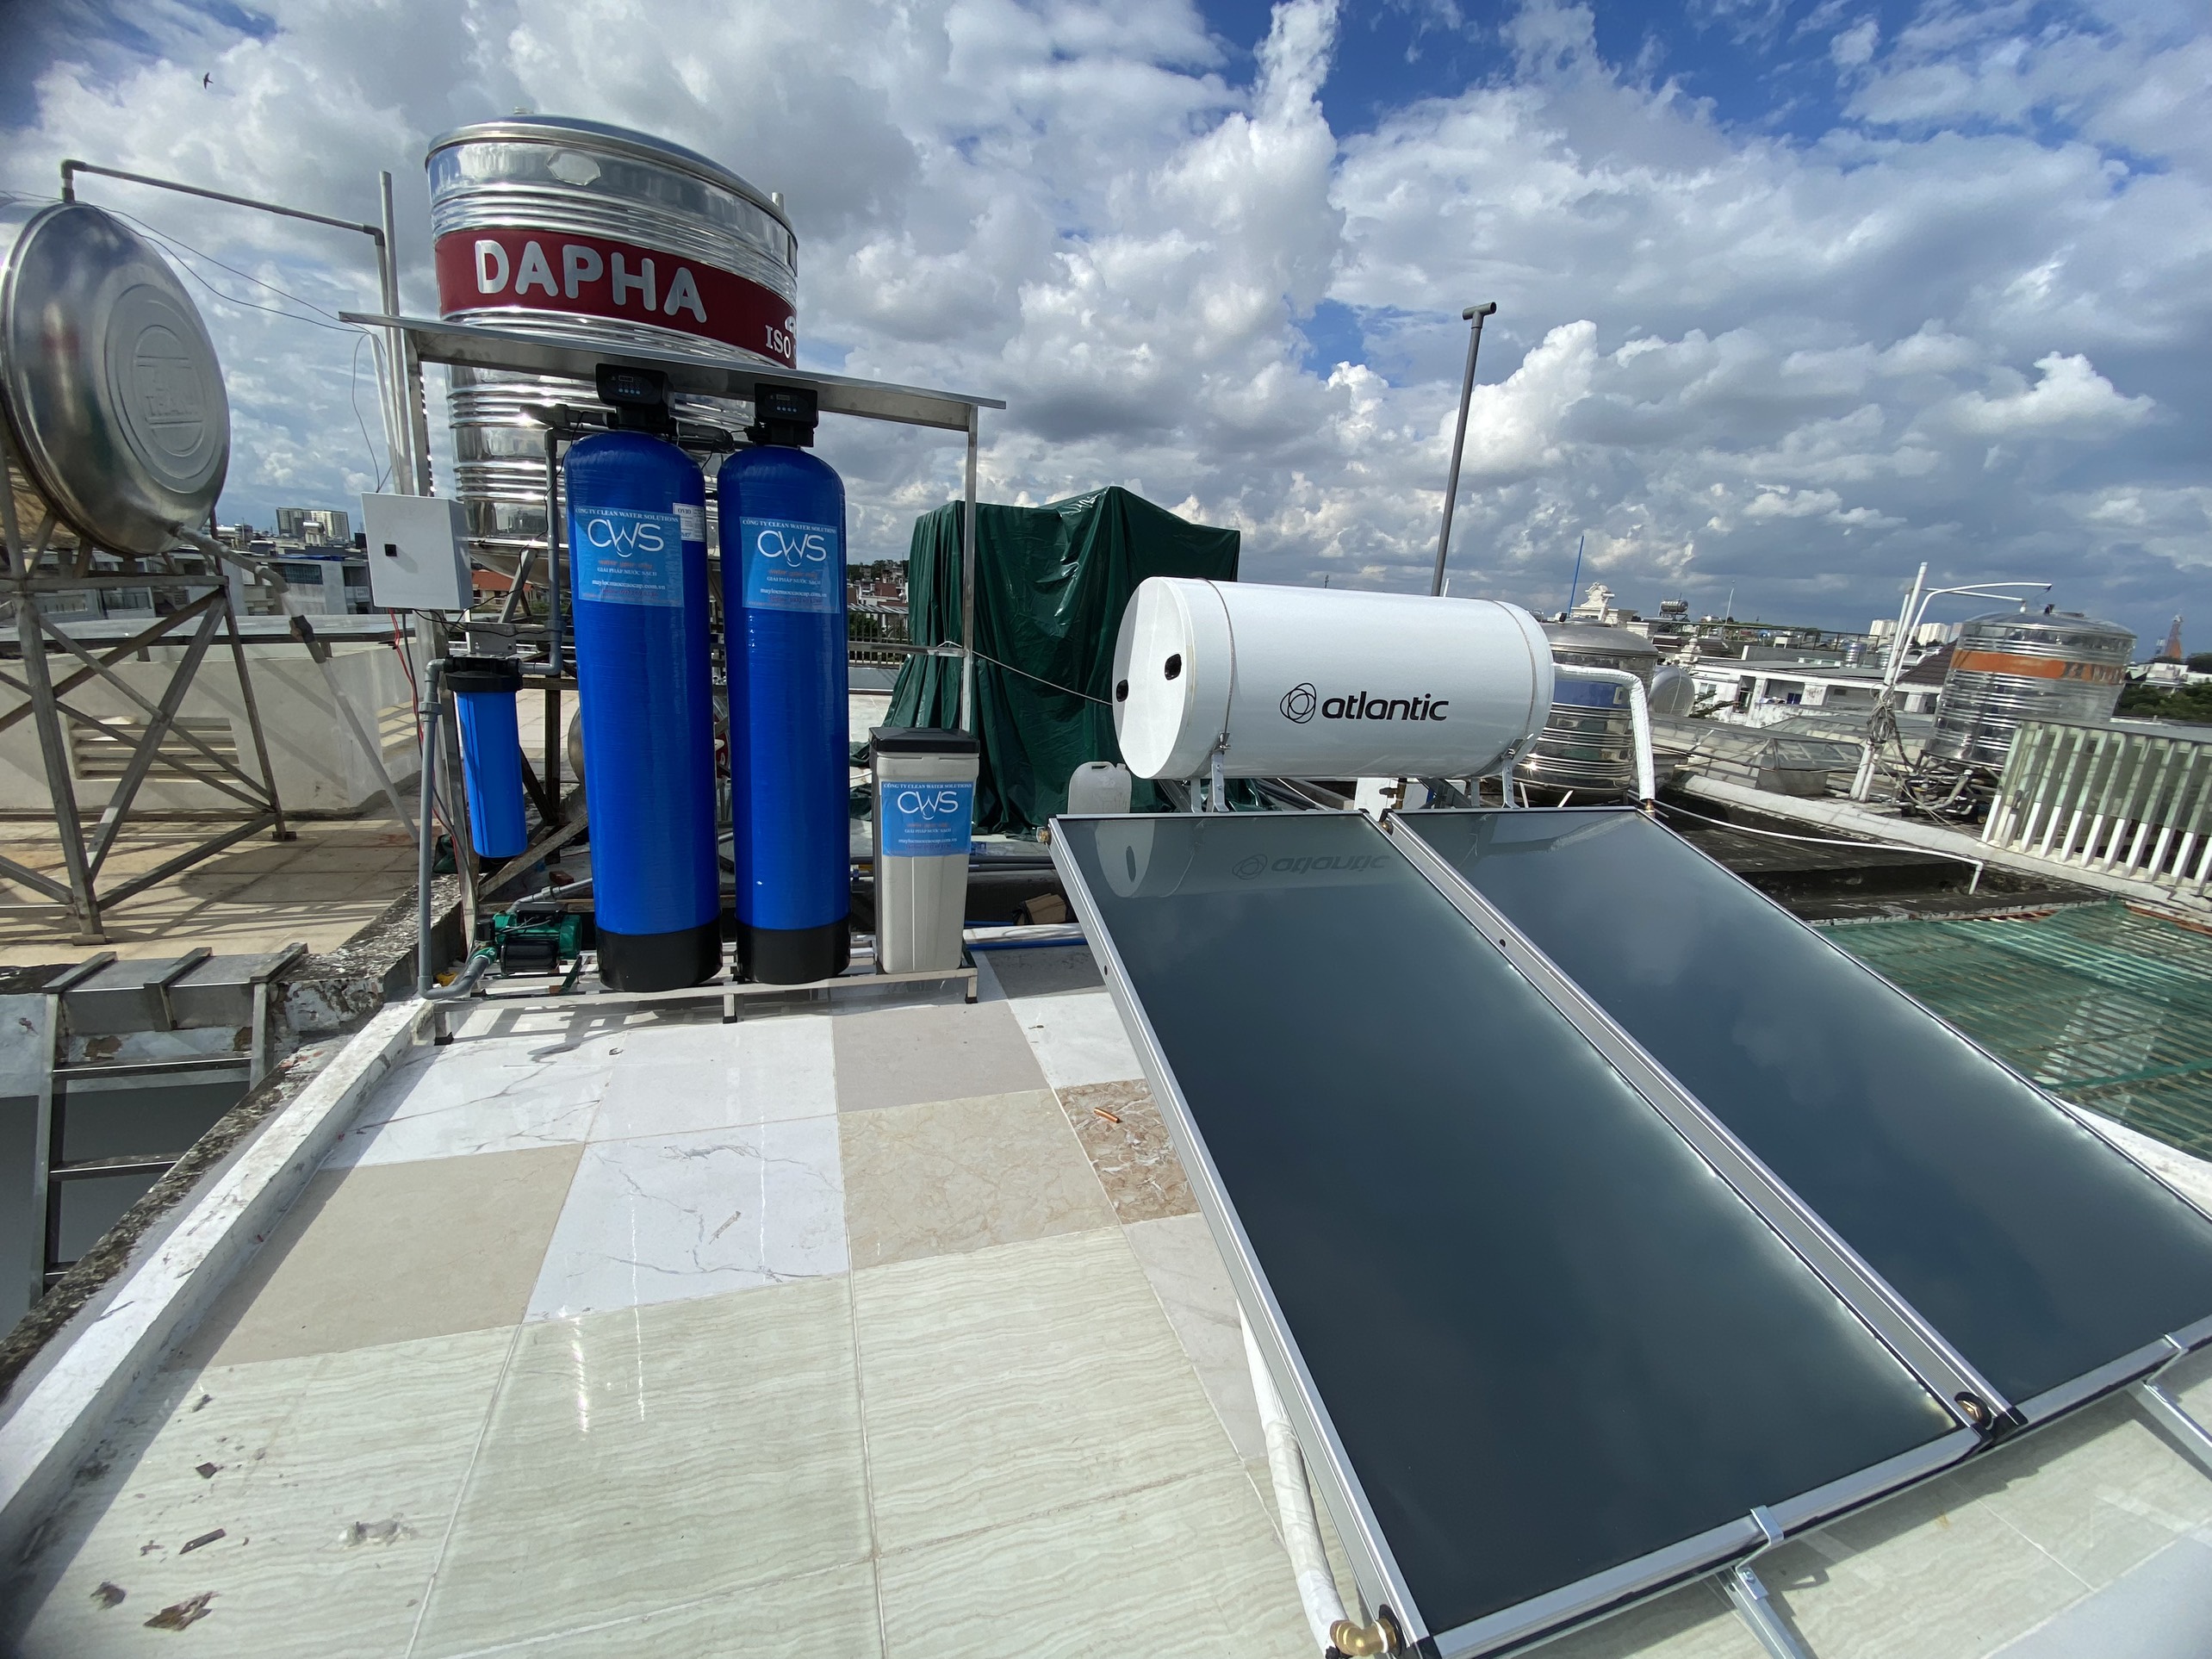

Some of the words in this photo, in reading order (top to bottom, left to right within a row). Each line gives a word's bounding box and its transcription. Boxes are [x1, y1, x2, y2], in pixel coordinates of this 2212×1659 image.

[475, 239, 707, 323] DAPHA
[765, 325, 792, 359] ISO
[587, 519, 664, 557] CWS
[758, 530, 826, 567] CWS
[1321, 691, 1449, 722] atlantic
[897, 791, 959, 821] CWS
